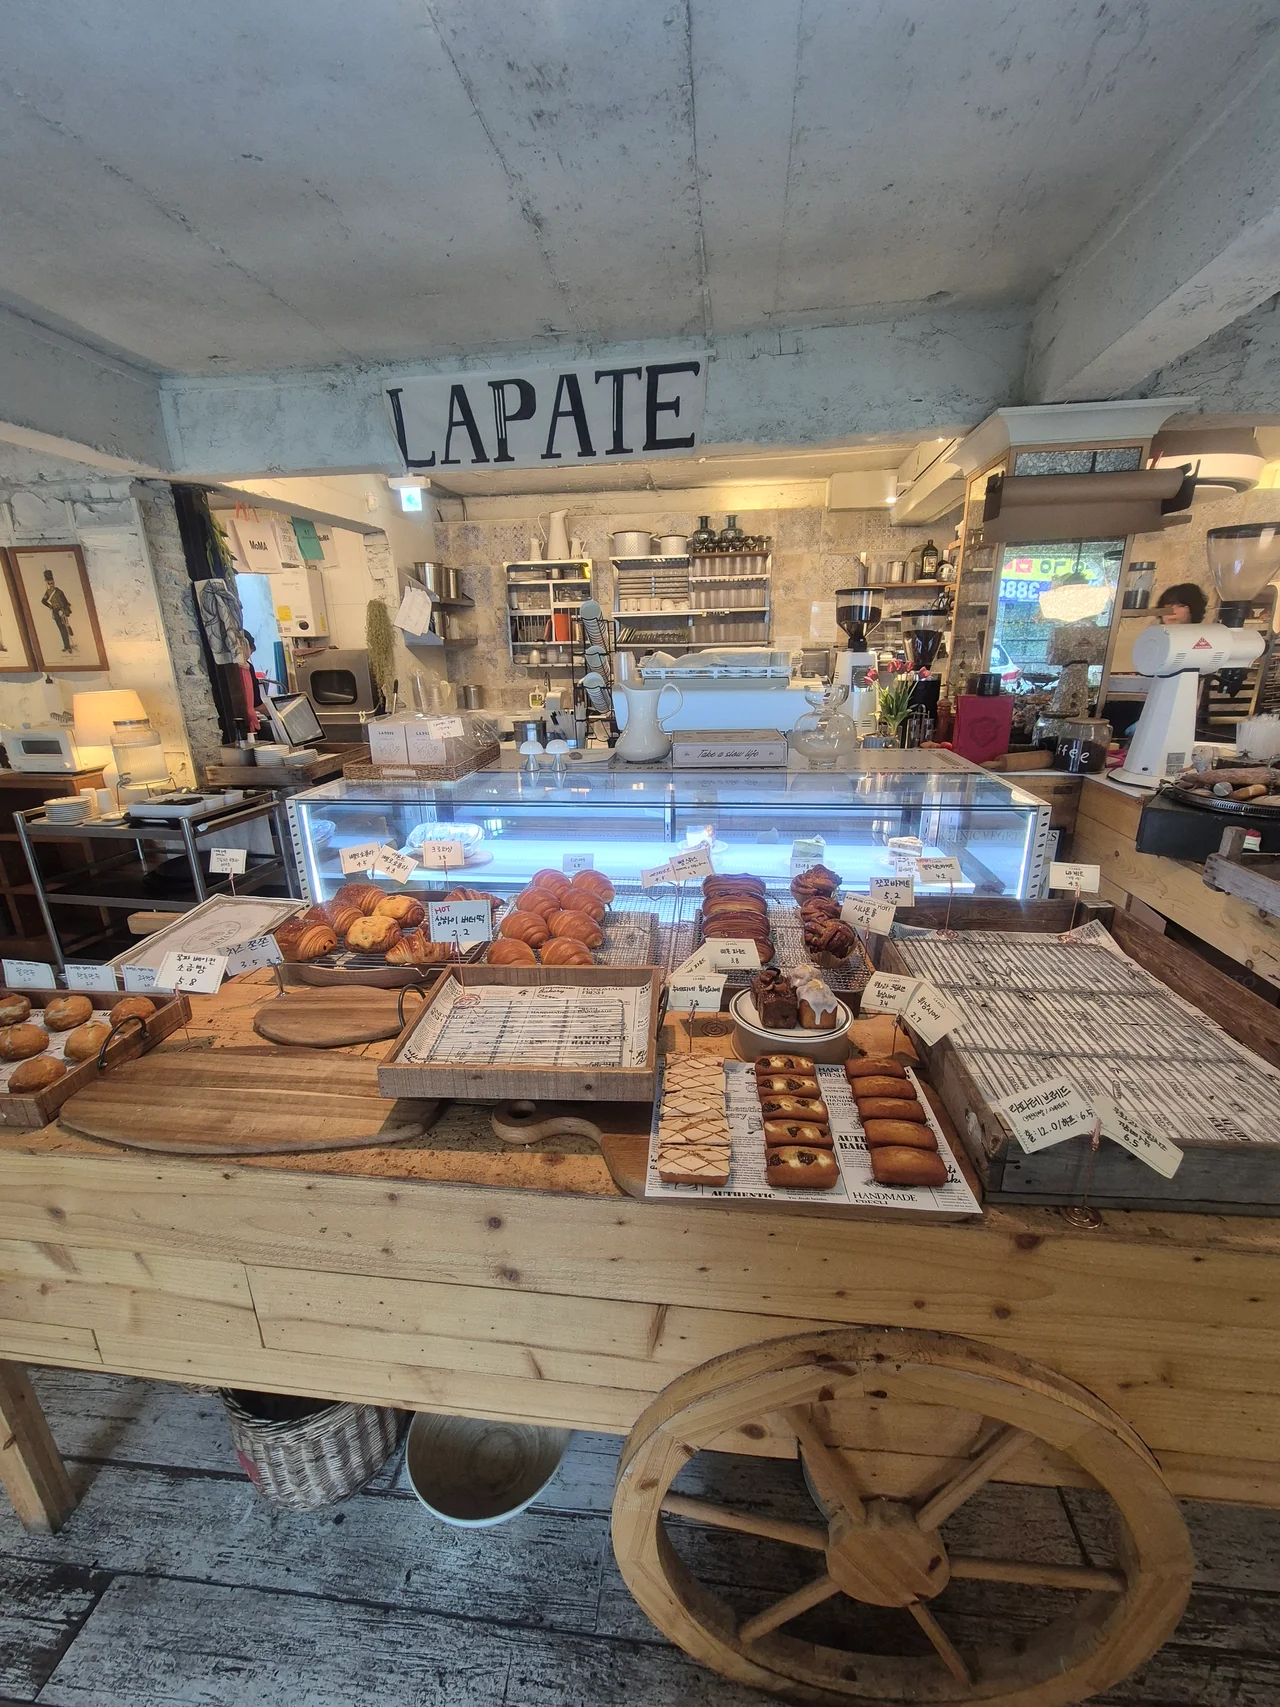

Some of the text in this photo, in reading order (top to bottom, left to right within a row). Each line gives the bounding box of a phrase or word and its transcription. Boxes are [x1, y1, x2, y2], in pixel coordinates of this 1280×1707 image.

[386, 361, 701, 468] LAPATE
[248, 540, 269, 551] MoMA
[697, 749, 716, 759] Take
[725, 749, 744, 758] slow
[744, 749, 760, 760] life
[884, 891, 900, 900] 5.2
[434, 905, 450, 915] HOT
[857, 915, 871, 924] 4.5
[451, 928, 470, 937] 2.2
[241, 959, 259, 968] 3.5
[177, 976, 197, 986] 5.8
[910, 1012, 921, 1023] 2.7
[1123, 1133, 1139, 1148] 6.5
[710, 1190, 776, 1199] AUTHENTIC
[853, 1191, 918, 1202] HANDMADE
